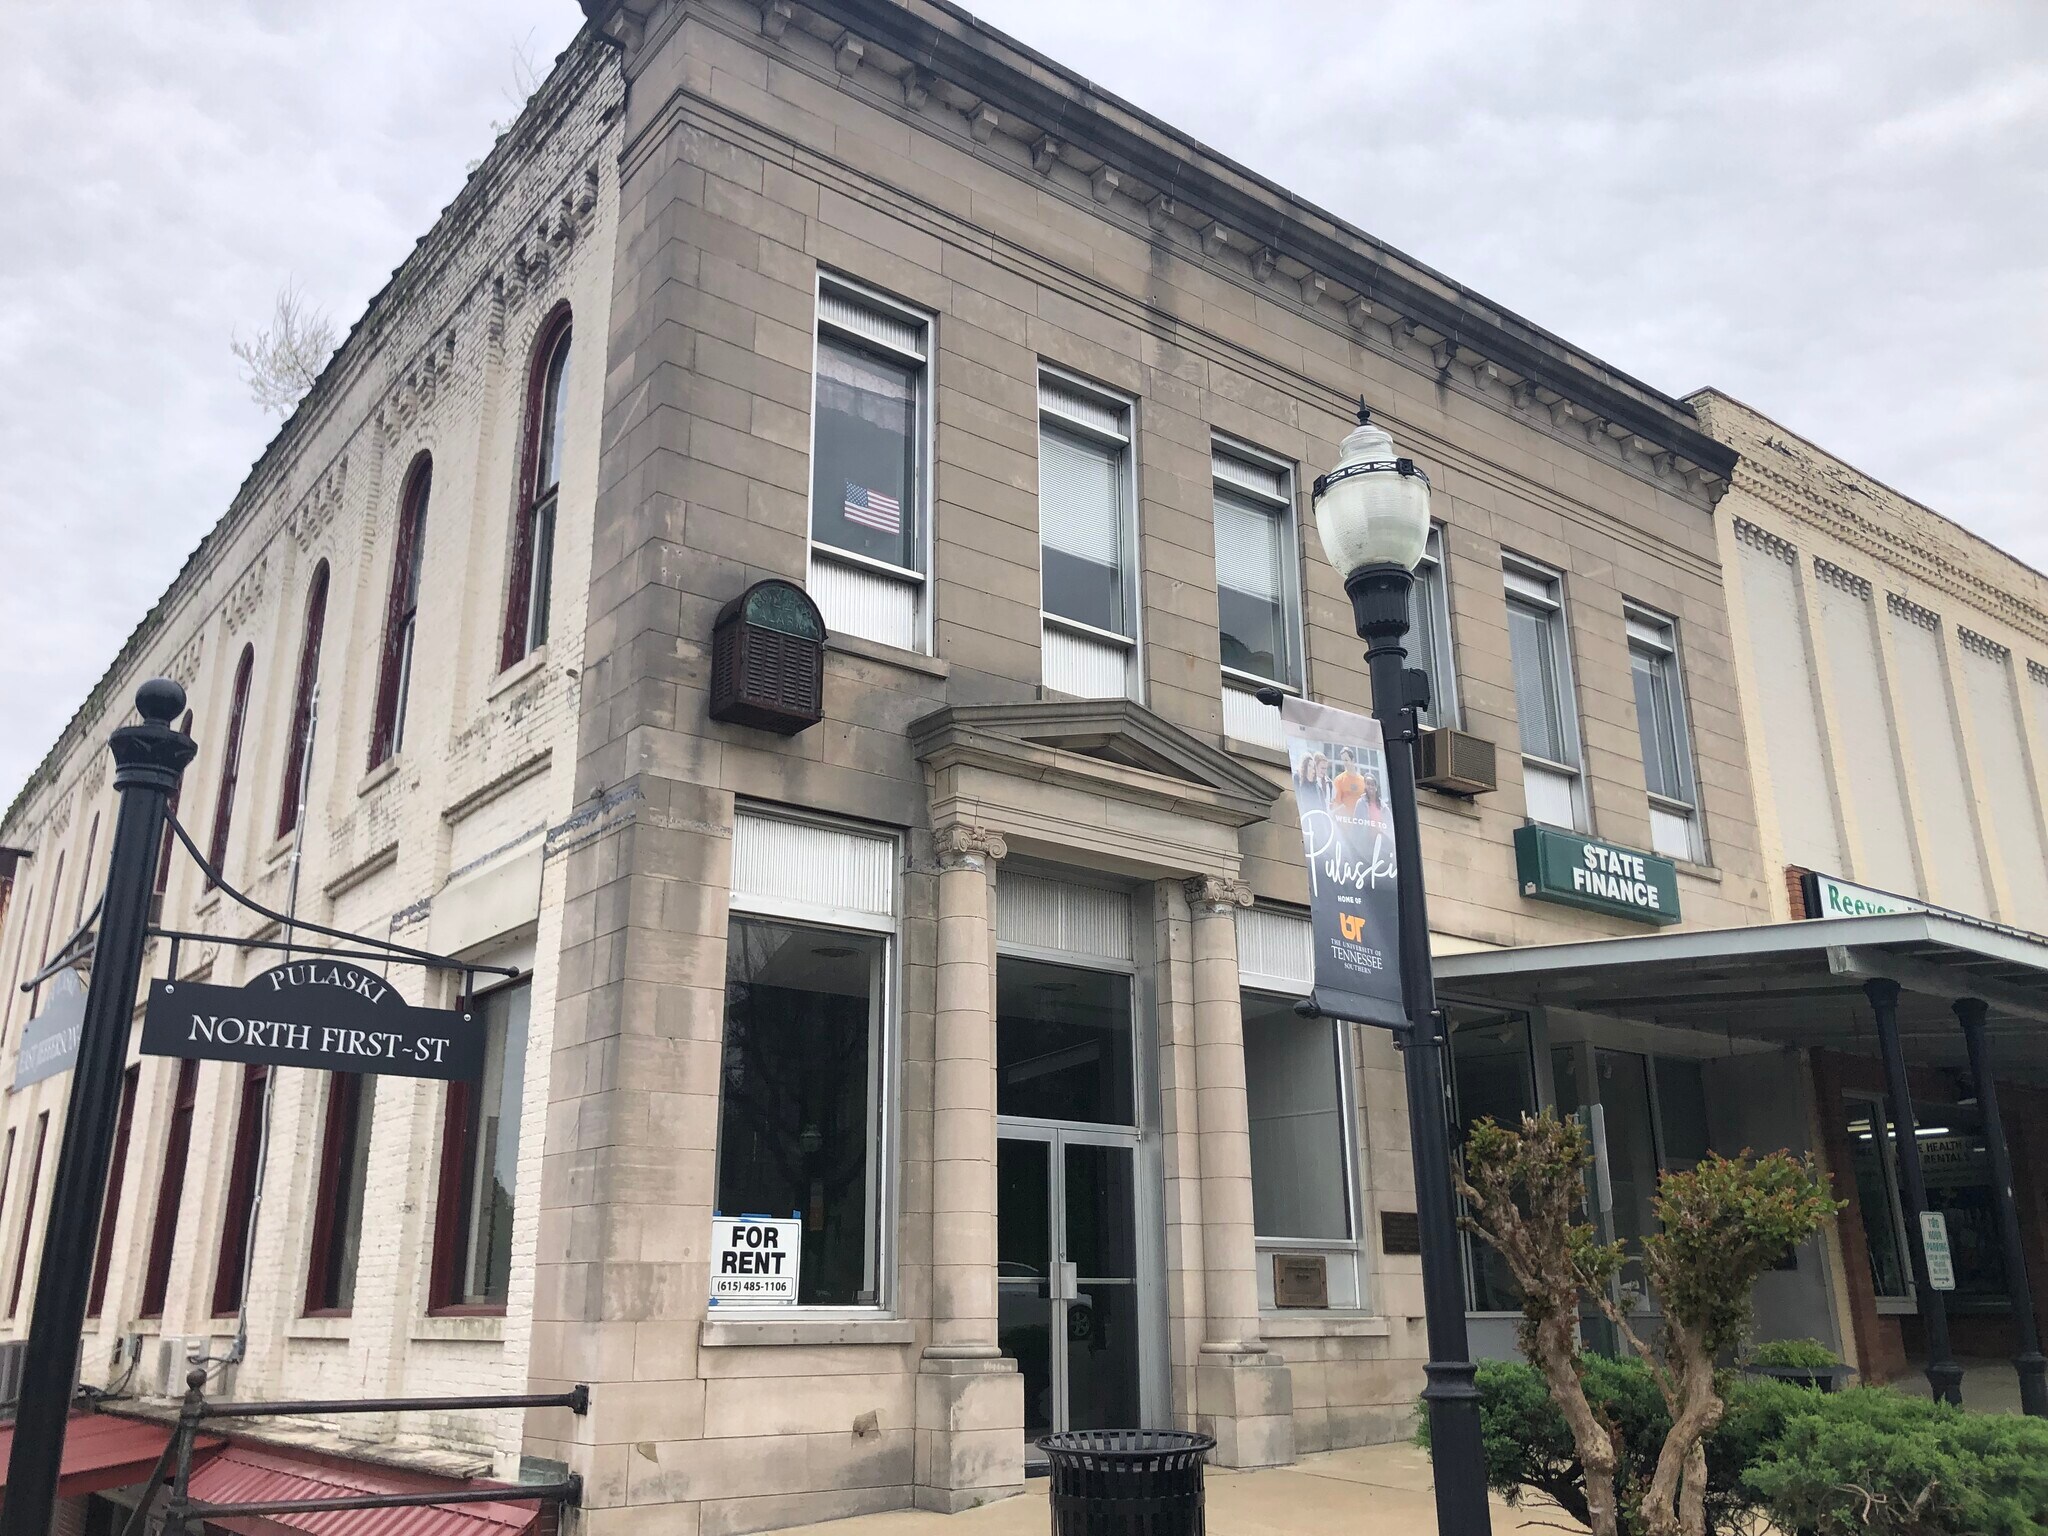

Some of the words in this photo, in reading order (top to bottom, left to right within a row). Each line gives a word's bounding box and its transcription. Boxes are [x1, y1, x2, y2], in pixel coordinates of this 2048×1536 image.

[1335, 815, 1376, 827] WELCOME
[1378, 821, 1387, 829] TO
[1301, 809, 1398, 897] Pulaski
[1337, 895, 1354, 904] HOME
[1572, 867, 1660, 909] FINANCE
[1827, 884, 1895, 915] Reeve
[1339, 911, 1366, 943] UT
[1331, 937, 1341, 946] THE
[1342, 941, 1374, 955] UNIVERSITY
[1331, 945, 1383, 970] TENNESSEE
[1344, 962, 1372, 974] SOUTHERN
[269, 964, 387, 1004] PULASKI
[187, 1014, 312, 1050] NORTH
[732, 1226, 779, 1248] FOR
[721, 1251, 786, 1275] RENT
[717, 1281, 741, 1292] (615)
[744, 1281, 787, 1292] 485-1106
